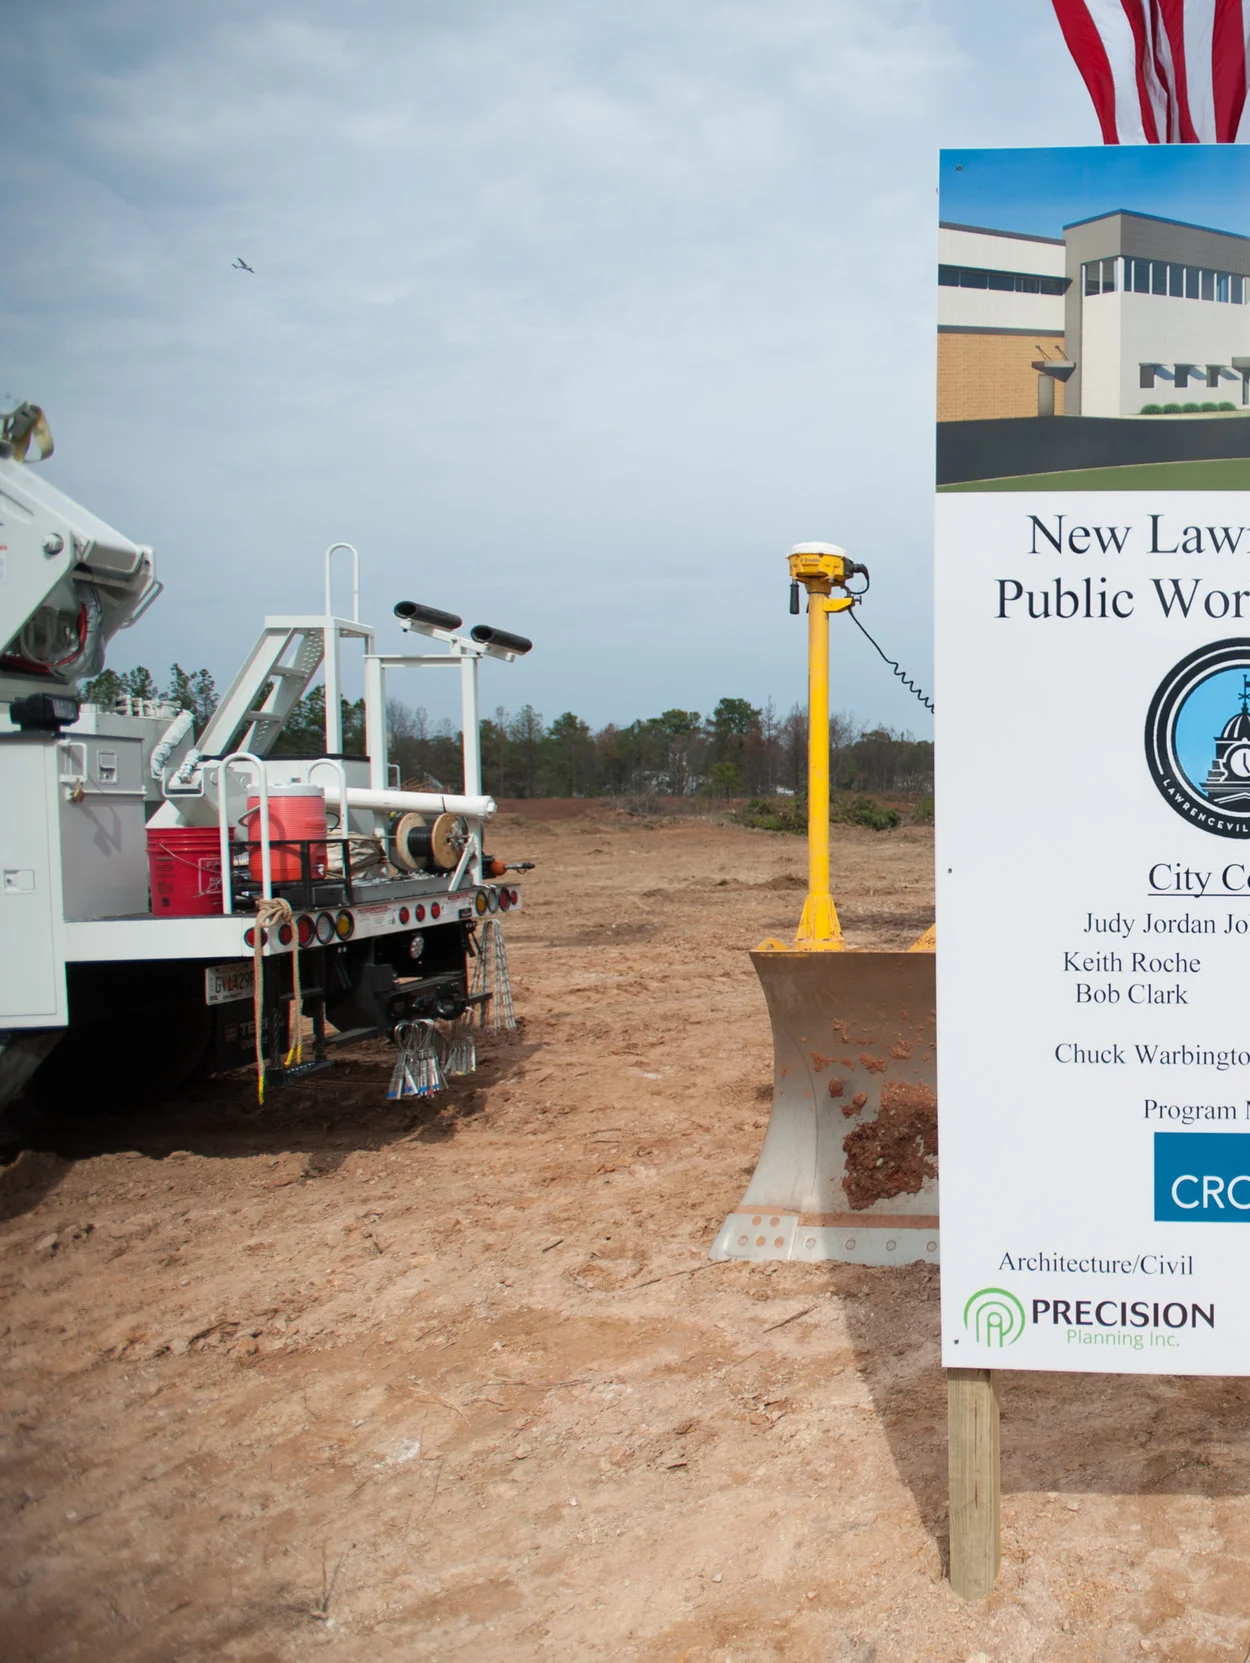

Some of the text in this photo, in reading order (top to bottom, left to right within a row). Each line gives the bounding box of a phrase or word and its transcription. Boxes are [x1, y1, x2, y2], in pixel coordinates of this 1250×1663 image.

[1025, 514, 1132, 555] New
[993, 576, 1135, 620] Public
[1148, 863, 1213, 898] City
[1083, 912, 1135, 938] Judy
[1142, 912, 1216, 934] Jordan
[1063, 951, 1201, 974] Keith Roche
[1076, 983, 1189, 1005] Bob Clark
[1054, 1043, 1126, 1065] Chuck
[1144, 1099, 1237, 1125] Program
[998, 1251, 1193, 1276] Architecture/Civil
[1032, 1299, 1215, 1329] PRECISION
[1067, 1329, 1180, 1350] Planning Inc.
